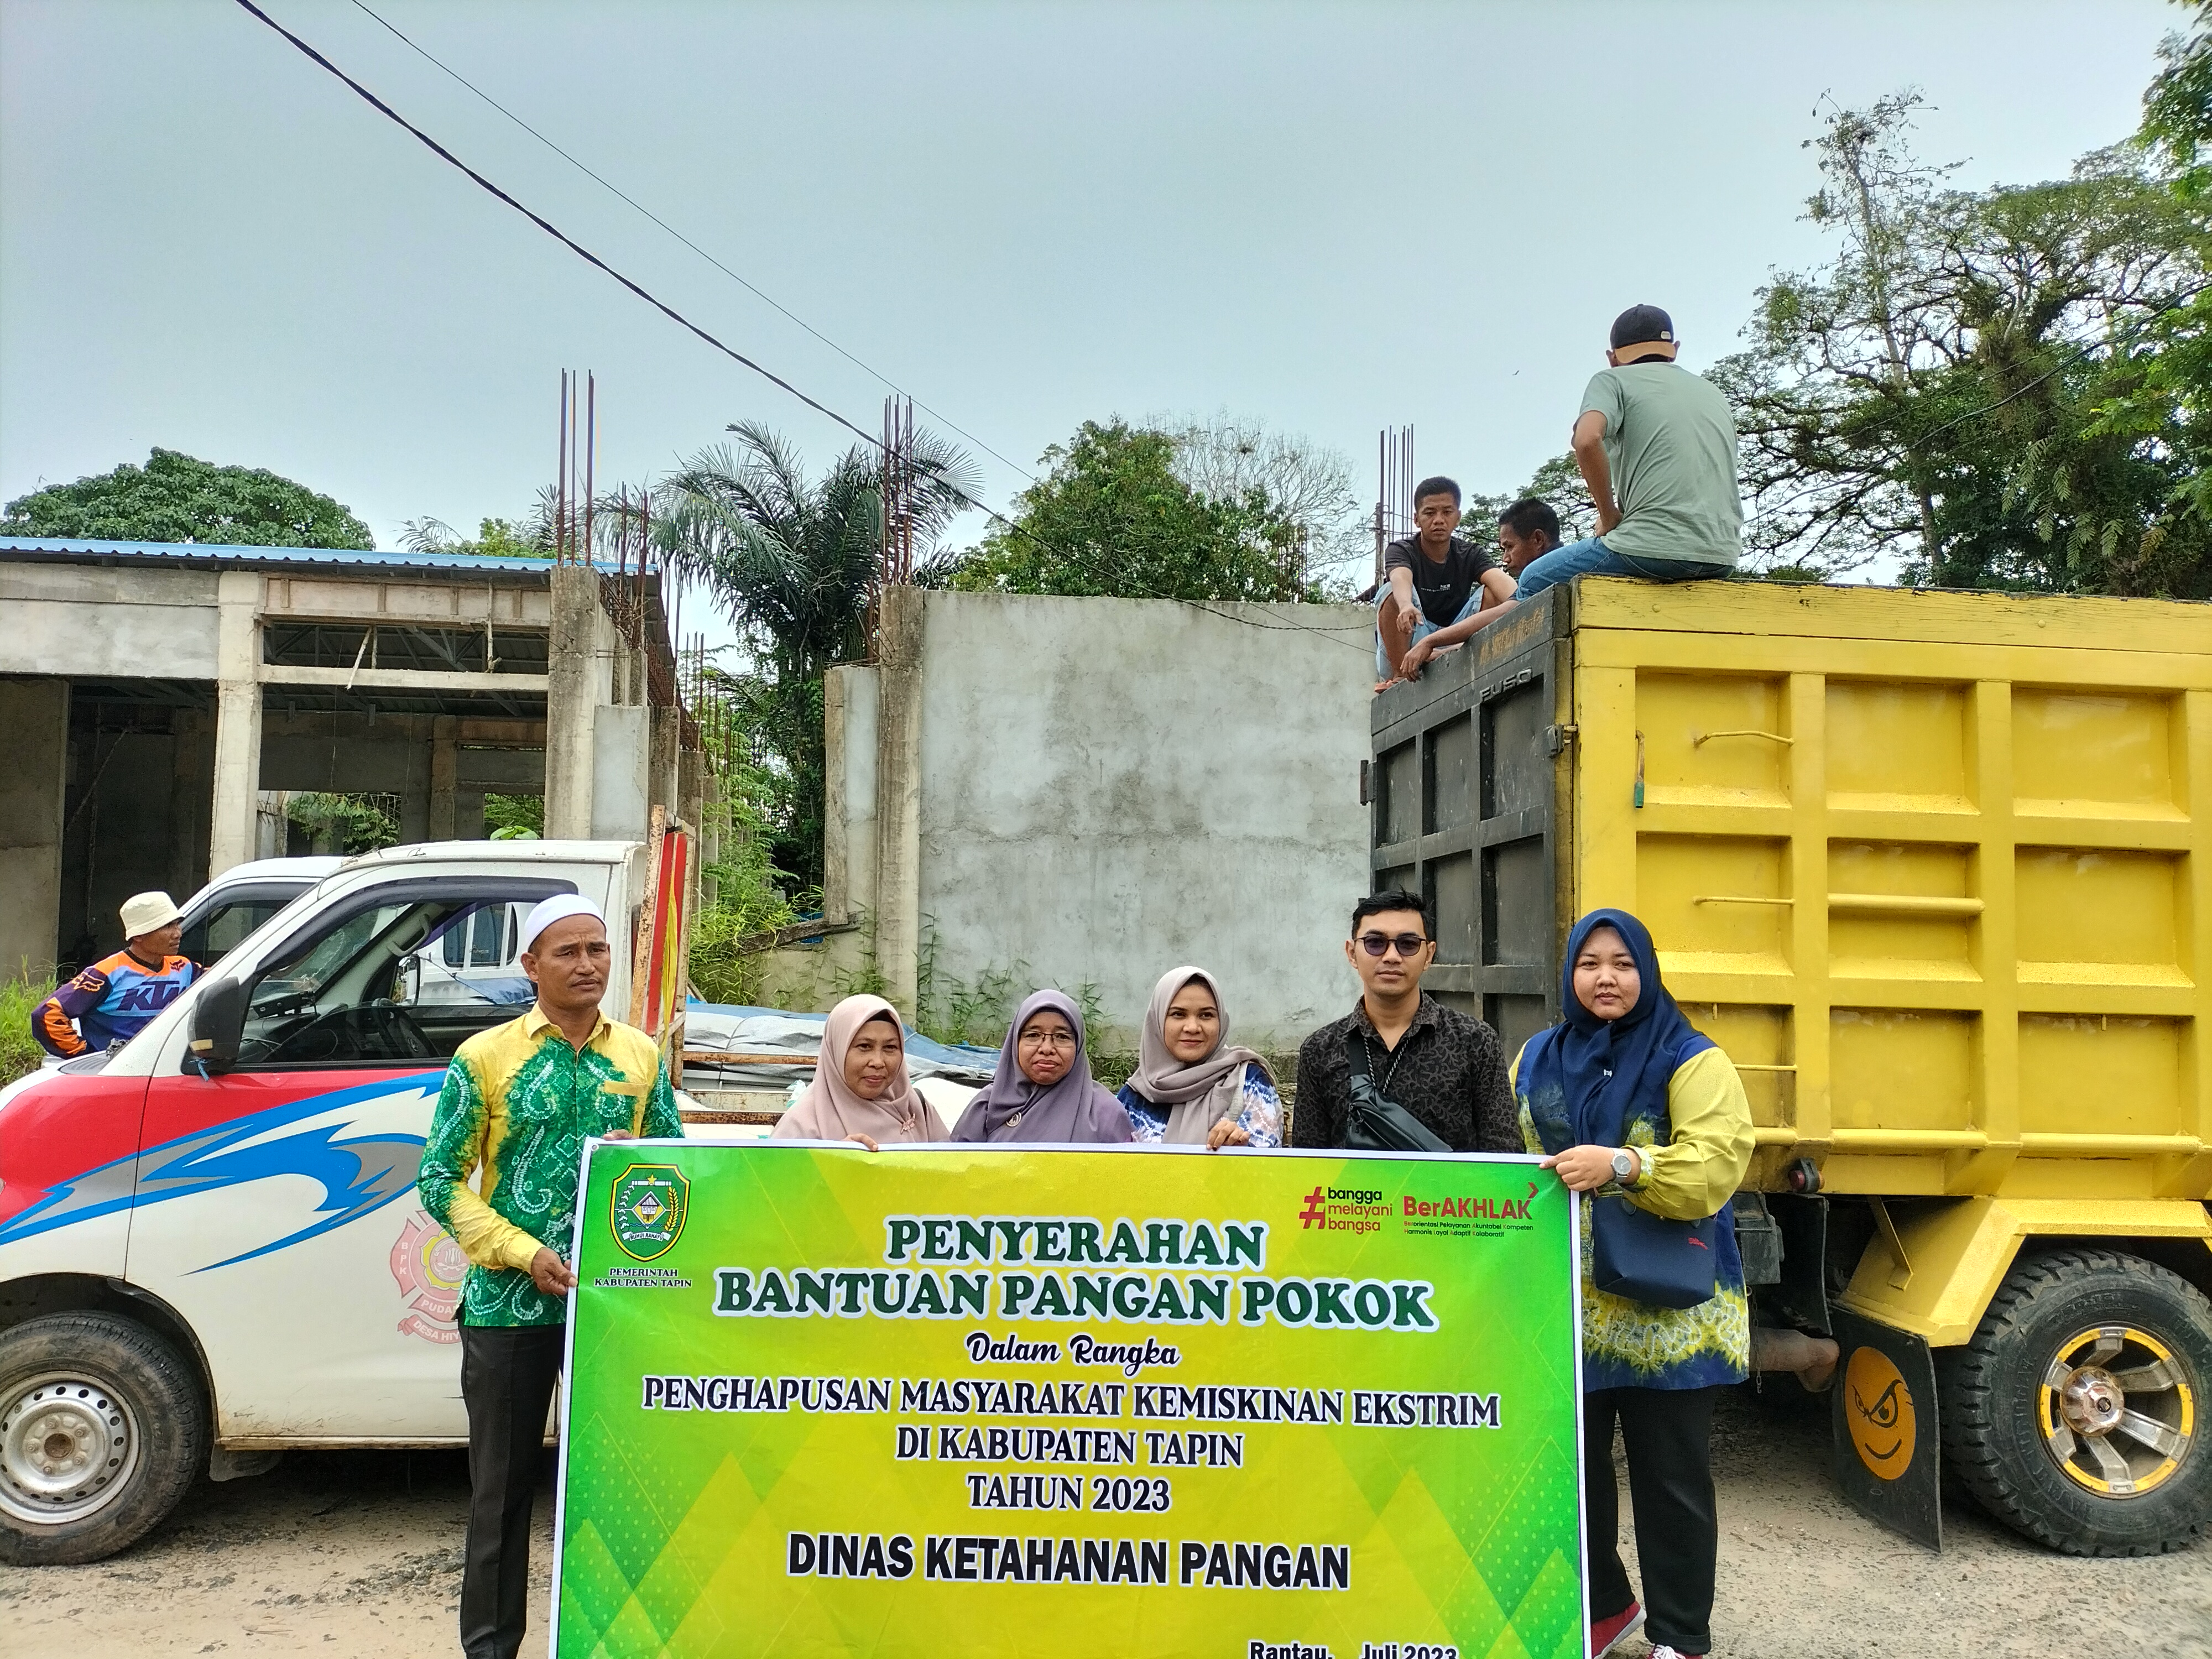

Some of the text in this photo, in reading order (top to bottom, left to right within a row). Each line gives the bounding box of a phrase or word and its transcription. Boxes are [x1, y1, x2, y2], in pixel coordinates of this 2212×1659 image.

[1480, 668, 1531, 701] FUSO
[1328, 1187, 1382, 1204] bangga
[1328, 1202, 1392, 1219] melayani
[1404, 1196, 1533, 1220] BerAKHLAK
[1328, 1217, 1381, 1235] bangsa
[887, 1219, 1265, 1267] PENYERAHAN
[594, 1278, 658, 1287] KABUPATEN
[609, 1268, 678, 1277] PEMERINTAH
[421, 1299, 456, 1314] PUDA
[717, 1271, 1434, 1327] BANTUAN PANGAN POKOK
[413, 1320, 439, 1339] DESA
[966, 1332, 1180, 1377] Dalam Rangka
[644, 1378, 1499, 1426] PENGHAPUSAN MASYARAKAT KEMISKINAN EKSTRIM
[896, 1427, 1243, 1466] DI KABUPATEN TAPIN
[968, 1475, 1170, 1511] TAHUN 2023
[789, 1533, 1348, 1588] DINAS KETAHANAN PANGAN
[1361, 1644, 1397, 1659] Juli
[1404, 1645, 1457, 1659] 2023
